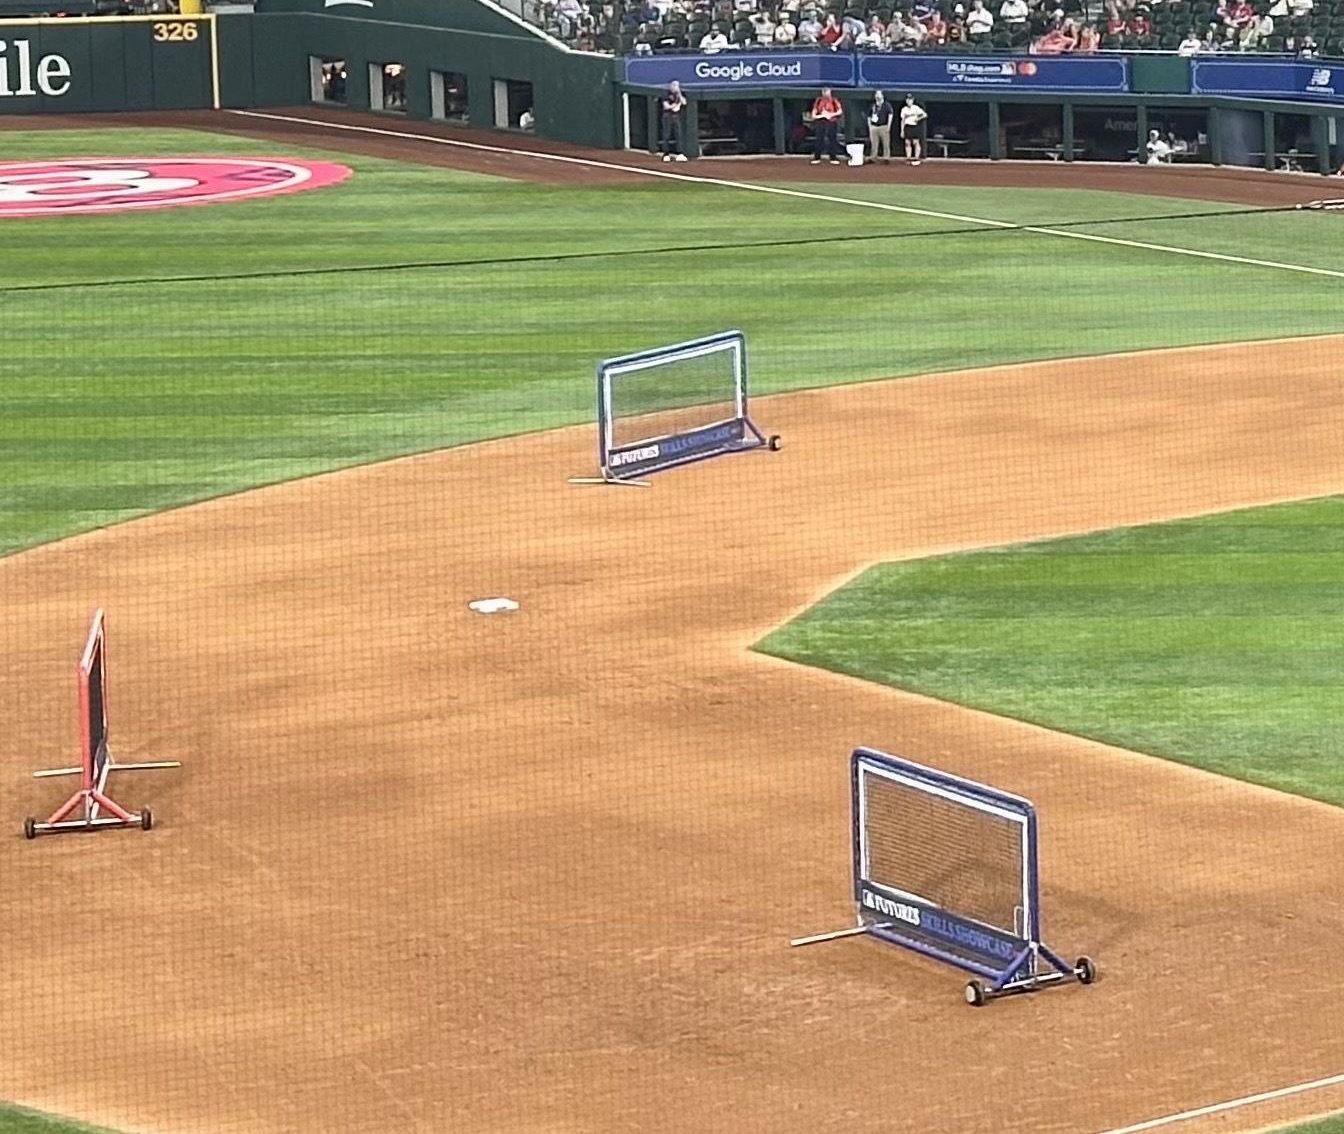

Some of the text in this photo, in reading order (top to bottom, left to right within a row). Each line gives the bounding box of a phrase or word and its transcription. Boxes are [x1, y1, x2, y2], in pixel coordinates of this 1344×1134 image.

[153, 22, 198, 42] 326
[695, 60, 801, 81] Google Cloud
[621, 445, 660, 465] FUTURES
[875, 894, 1014, 959] FUTURES SKILLS SHOWCASE
